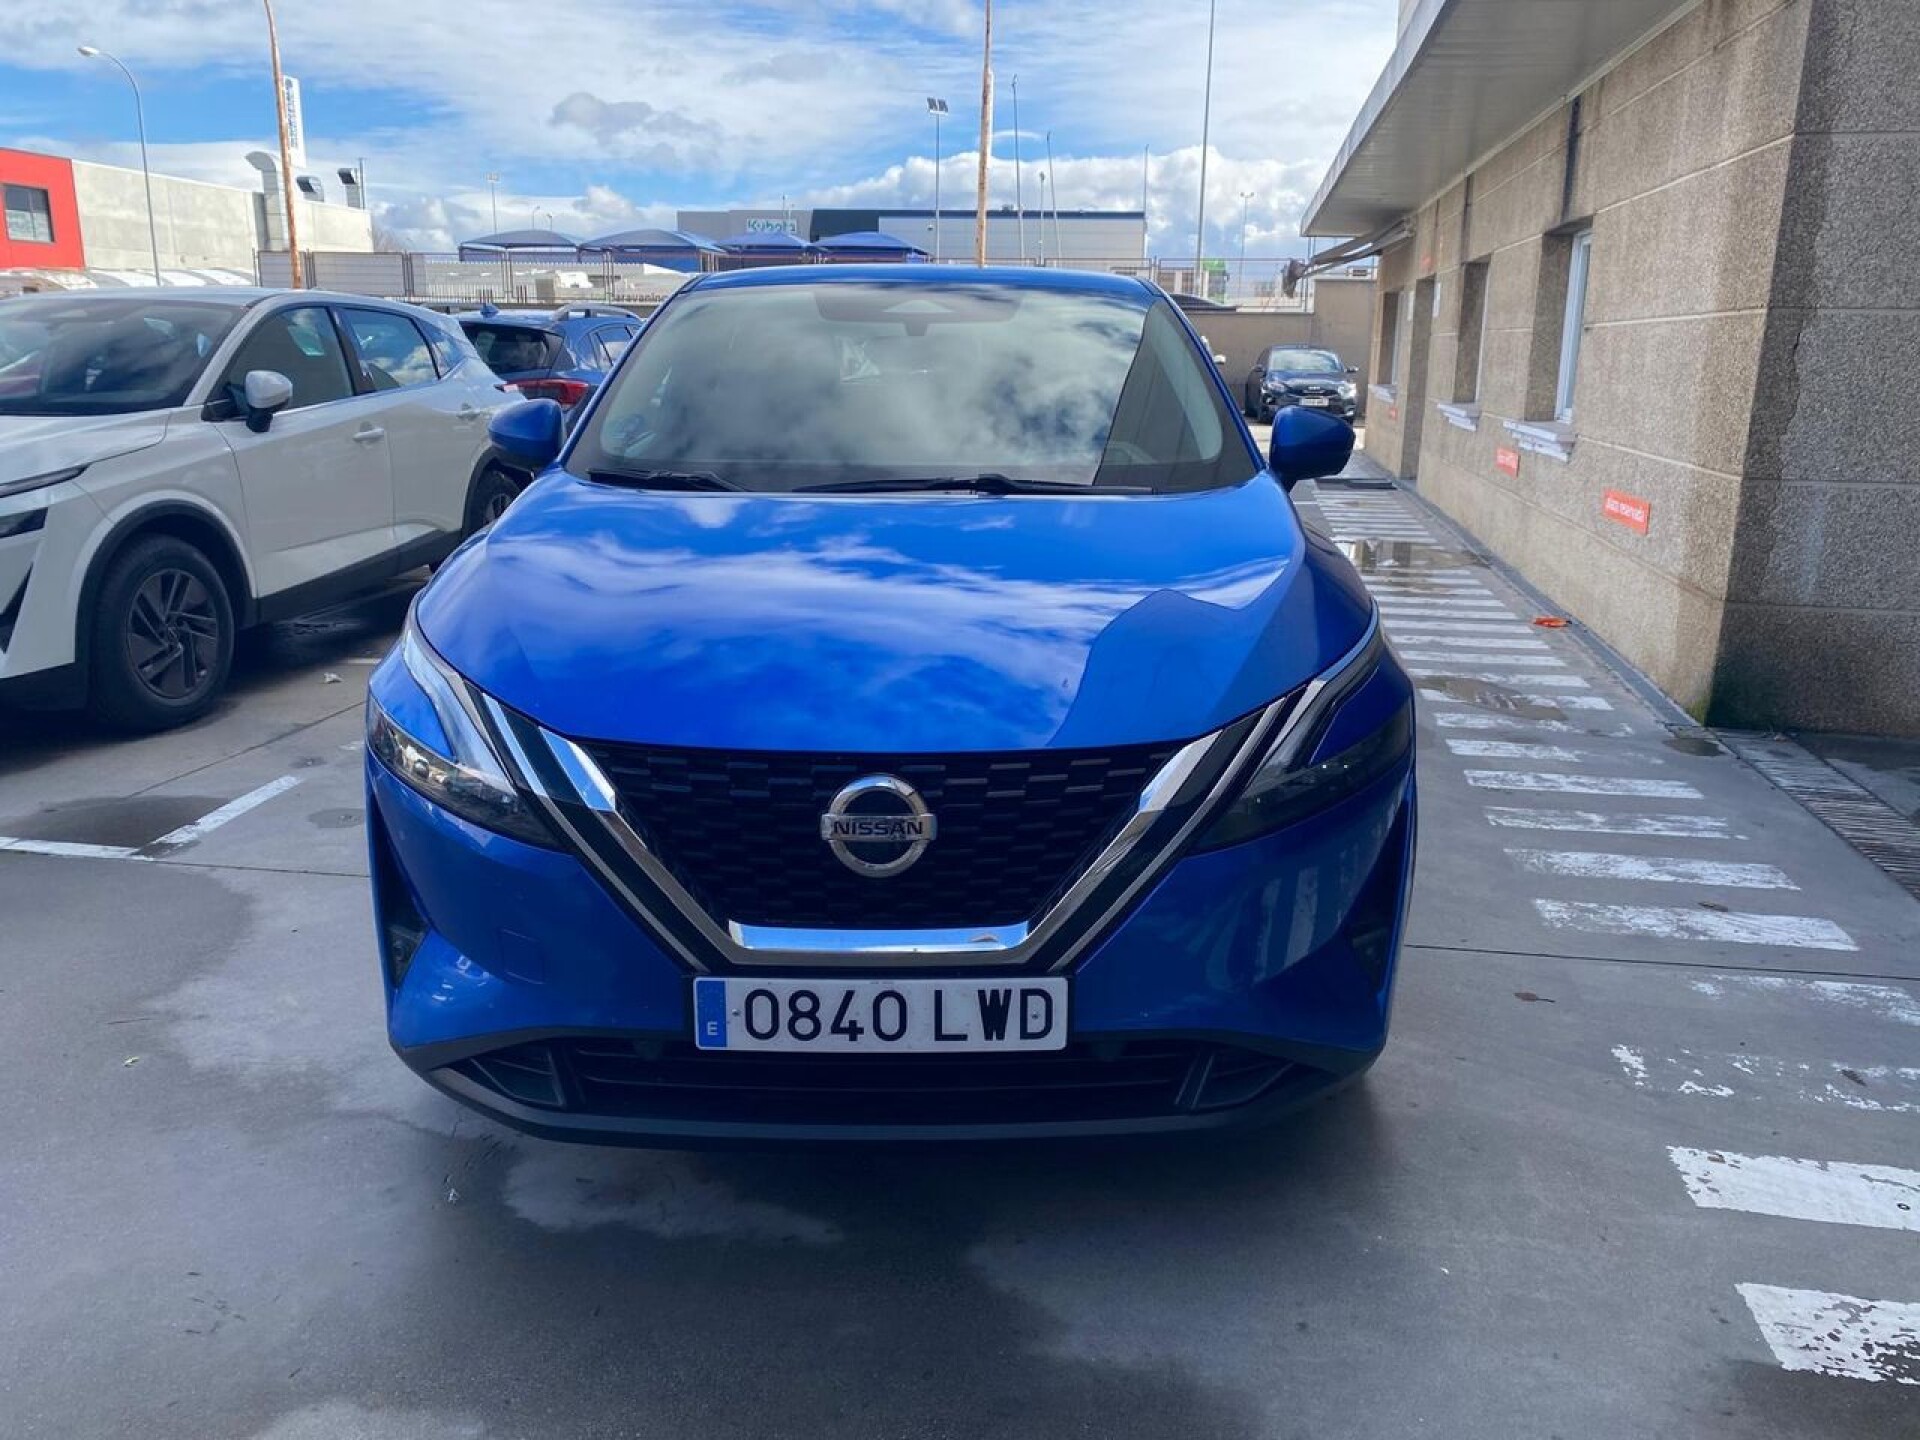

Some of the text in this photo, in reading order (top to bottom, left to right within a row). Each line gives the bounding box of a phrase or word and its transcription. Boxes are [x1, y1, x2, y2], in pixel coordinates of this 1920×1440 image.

[833, 821, 923, 835] NISSAN
[744, 988, 1053, 1042] 0840 LWD
[707, 1021, 718, 1036] E
